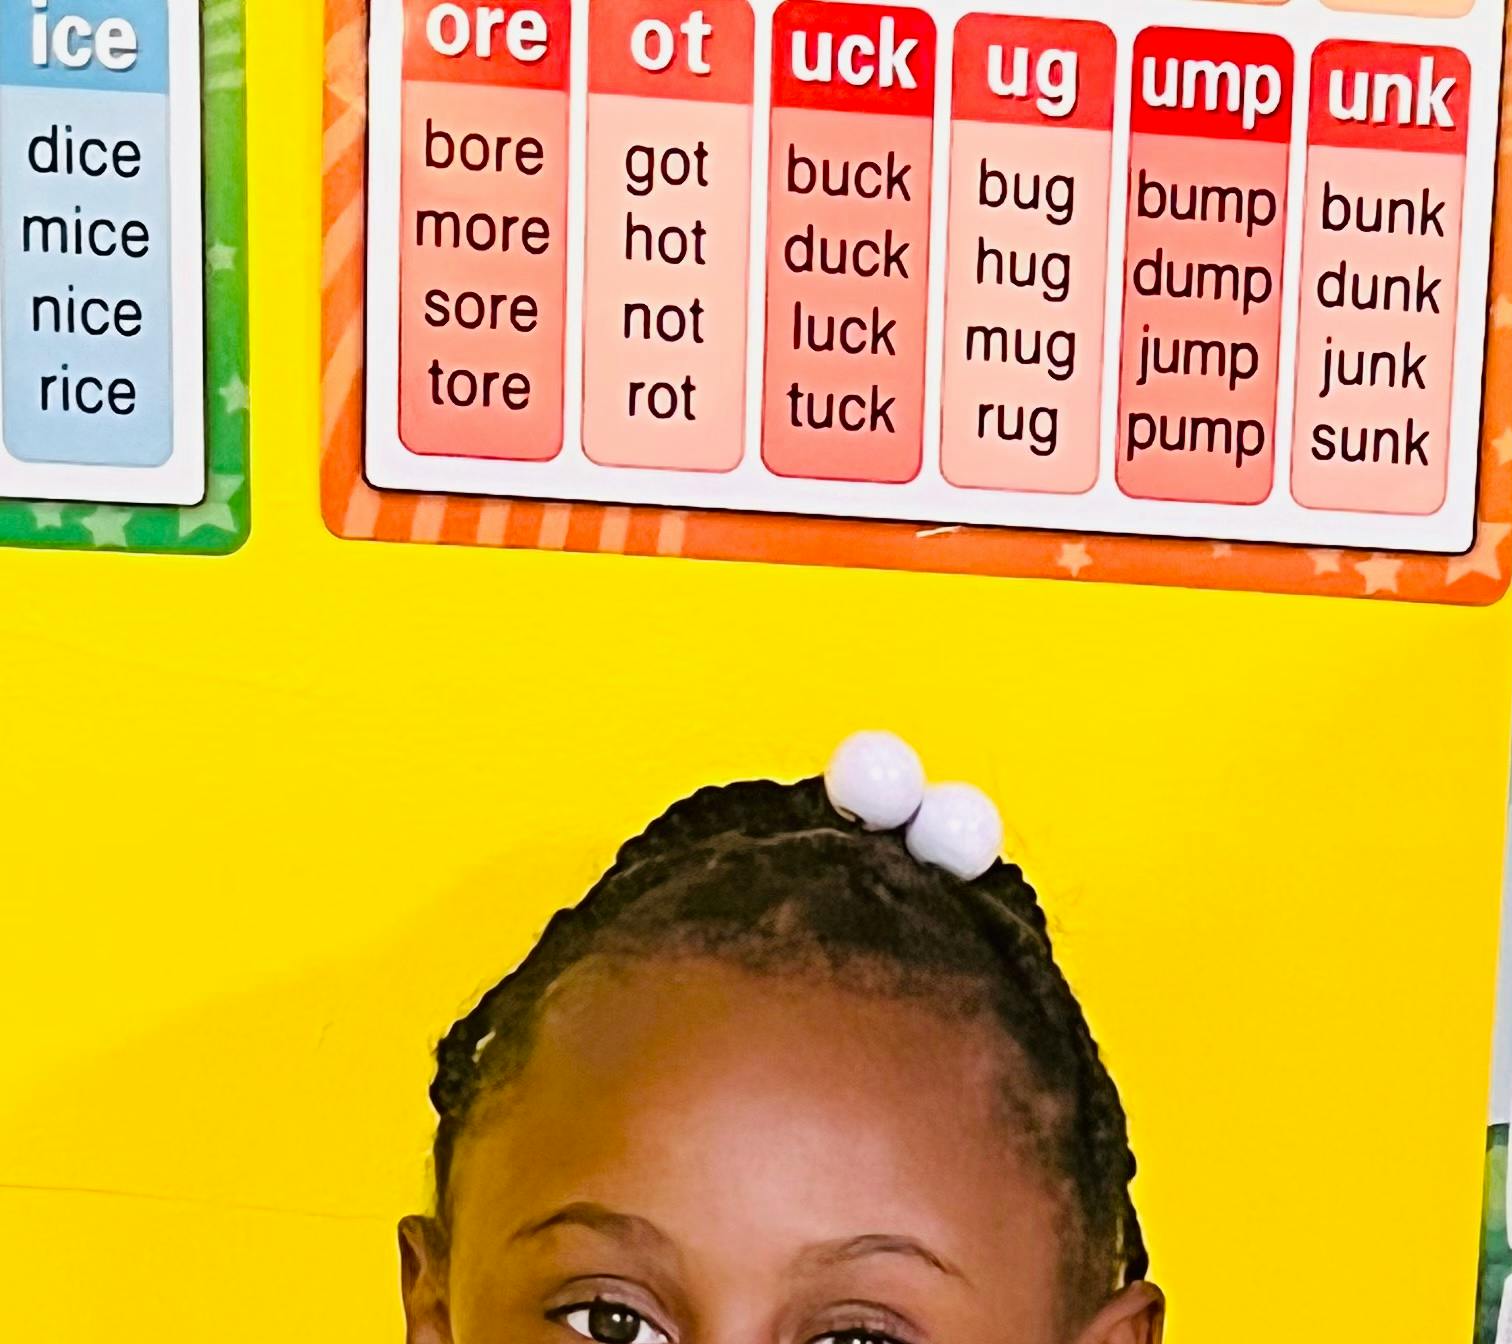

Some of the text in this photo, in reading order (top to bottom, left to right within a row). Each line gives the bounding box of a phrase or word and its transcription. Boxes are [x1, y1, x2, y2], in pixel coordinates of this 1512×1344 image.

[31, 0, 137, 68] ice
[426, 3, 548, 61] ore
[630, 14, 711, 74] ot
[791, 17, 918, 92] uck
[987, 40, 1078, 117] ug
[1142, 47, 1282, 132] ump
[1329, 56, 1457, 131] unk
[27, 125, 142, 178] dice
[425, 119, 545, 175] bore
[625, 139, 708, 195] got
[787, 144, 911, 202] buck
[979, 158, 1075, 224] bug
[1139, 169, 1276, 238] bump
[1323, 181, 1445, 238] bunk
[22, 205, 150, 258] mice
[416, 208, 550, 255] more
[625, 211, 707, 265] hot
[784, 224, 910, 279] duck
[977, 236, 1071, 300] hug
[1133, 248, 1273, 314] dump
[1317, 261, 1441, 314] dunk
[31, 284, 143, 337] nice
[424, 287, 538, 333] sore
[624, 297, 704, 344] not
[793, 301, 897, 357] luck
[966, 323, 1076, 380] mug
[1137, 323, 1258, 390] jump
[1319, 337, 1427, 397] junk
[39, 364, 137, 415] rice
[428, 360, 531, 411] tore
[627, 375, 696, 421] rot
[789, 382, 896, 434] tuck
[978, 397, 1058, 457] rug
[1127, 407, 1265, 468] pump
[1311, 417, 1429, 468] sunk
